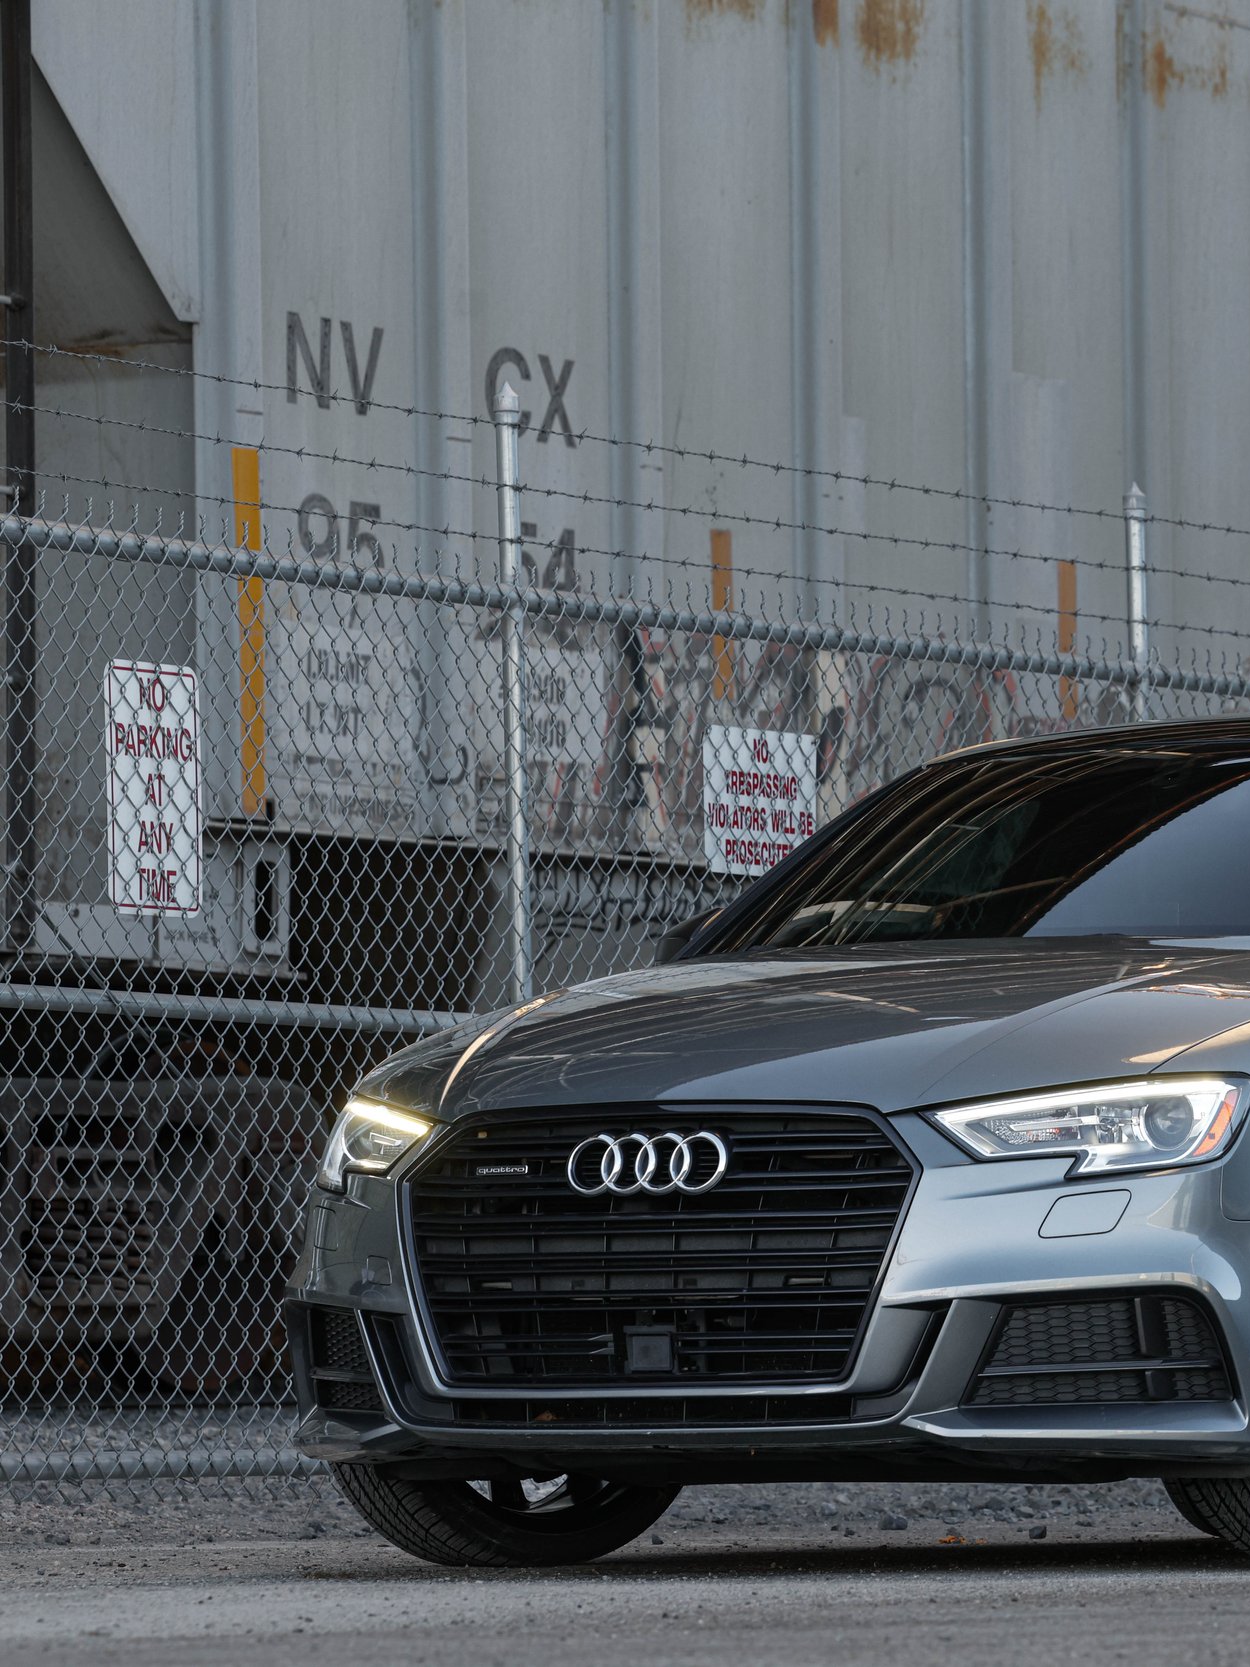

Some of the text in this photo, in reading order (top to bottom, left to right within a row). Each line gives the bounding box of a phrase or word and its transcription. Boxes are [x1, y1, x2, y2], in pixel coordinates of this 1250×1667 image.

[286, 310, 578, 450] NV CX
[139, 677, 166, 713] NO
[115, 722, 193, 762] PARKING
[753, 738, 769, 763] NO
[145, 773, 165, 807] AT
[725, 769, 798, 800] TRESPASSING
[708, 802, 814, 836] VIOLATORS WILL BE
[137, 820, 174, 854] ANY
[725, 838, 795, 867] PROSECUTE
[138, 867, 177, 903] TIME
[478, 1166, 525, 1175] quattro
